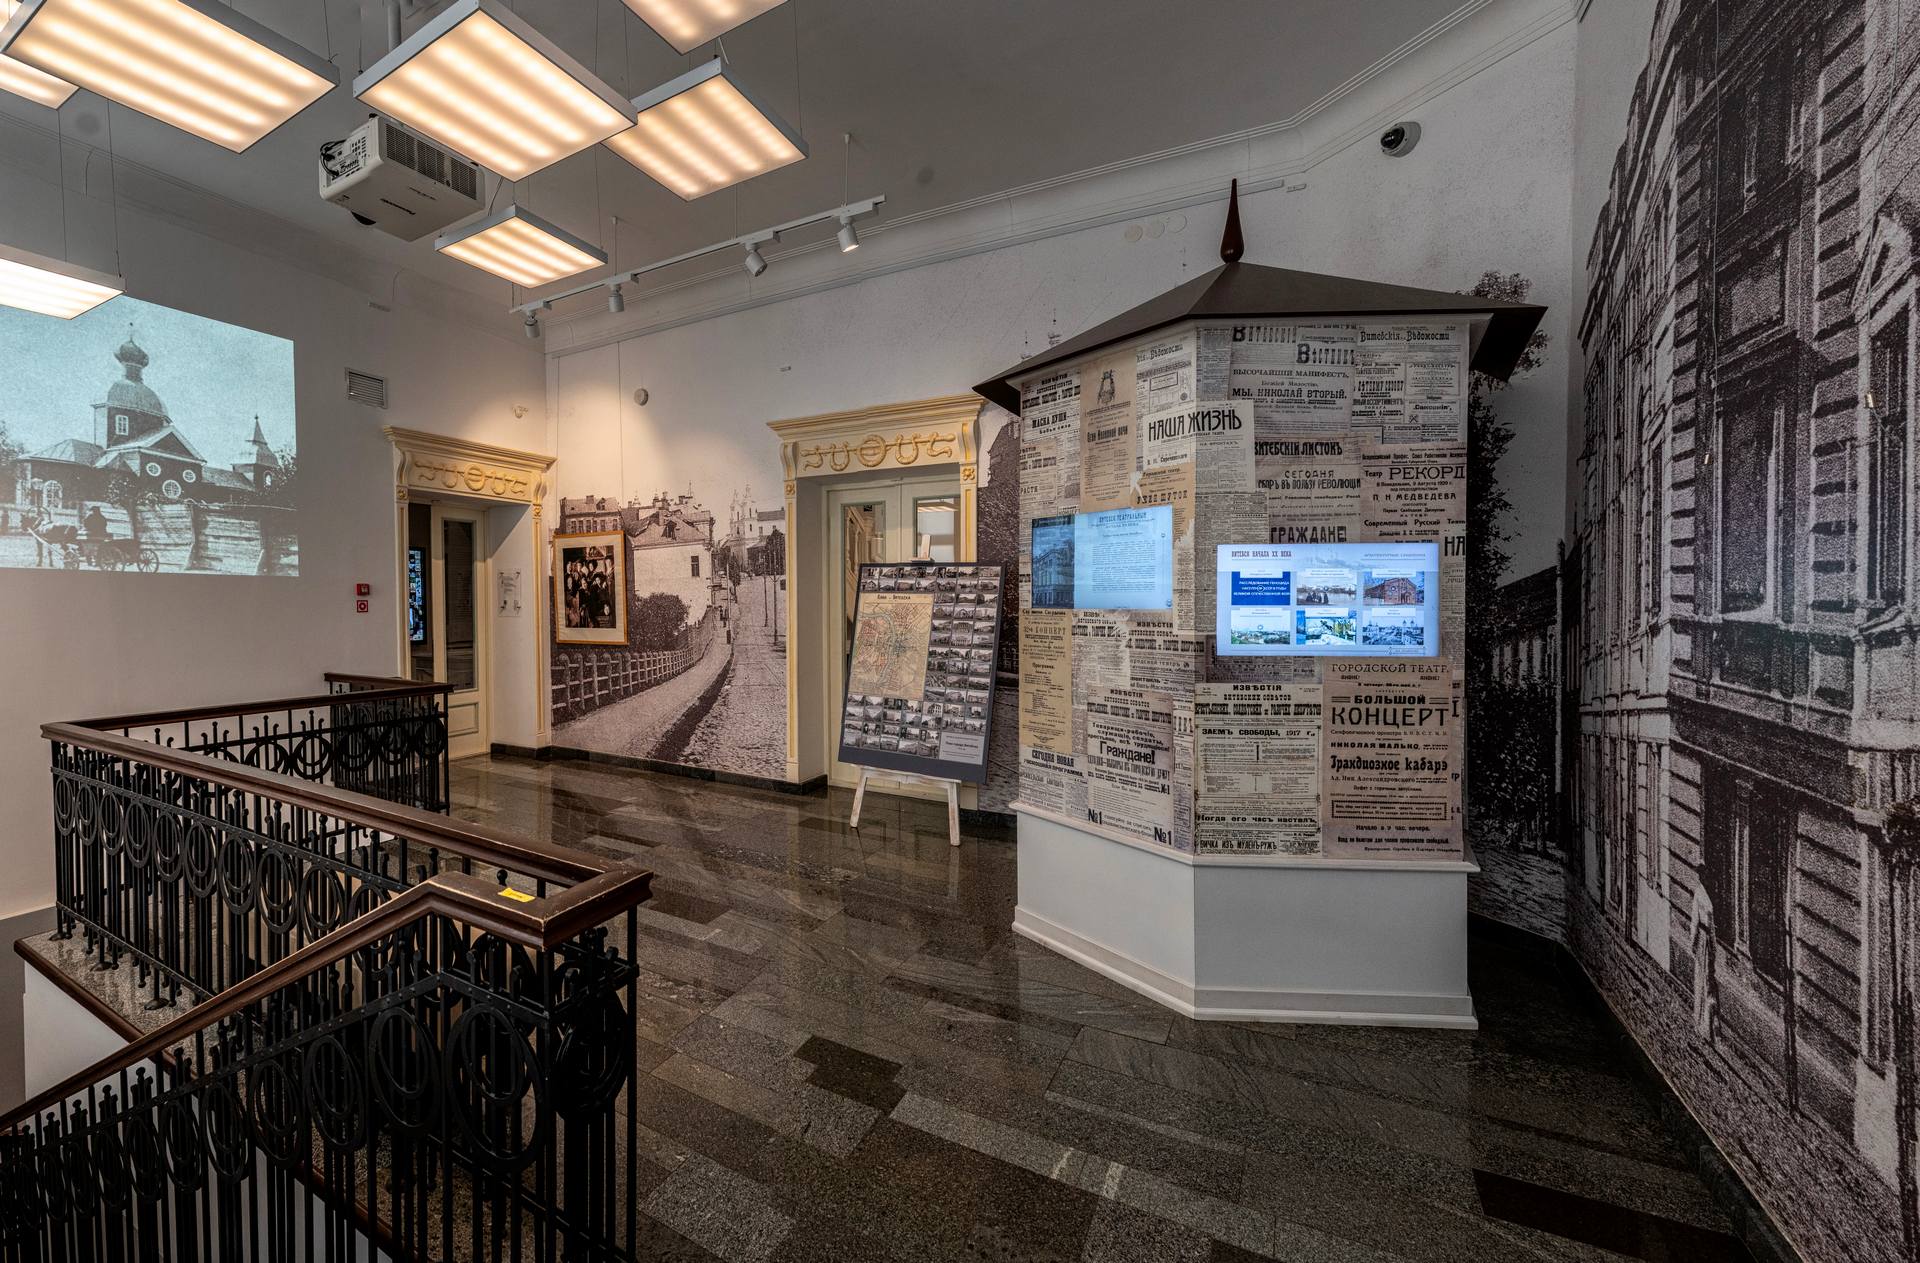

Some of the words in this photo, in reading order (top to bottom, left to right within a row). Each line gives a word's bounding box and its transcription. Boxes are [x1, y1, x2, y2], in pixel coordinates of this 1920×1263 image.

[1148, 414, 1185, 442] НАША
[1188, 408, 1243, 434] ЖИЗНЬ
[1284, 470, 1335, 479] СЕГОДНЯ
[1388, 465, 1466, 480] РЕКОРД
[1396, 492, 1457, 501] МЕДВЕДЕВА
[1331, 663, 1407, 673] ГОРОДСКОЙ
[1354, 694, 1426, 705] БОЛЬШОЙ
[1331, 706, 1449, 729] КОНЦЕРТ
[1202, 728, 1233, 736] ЗАЕМЪ
[1099, 741, 1156, 764] Граждане!
[1330, 755, 1401, 773] Грандиозное
[1405, 757, 1448, 774] кабарэ
[1154, 826, 1171, 845] №1
